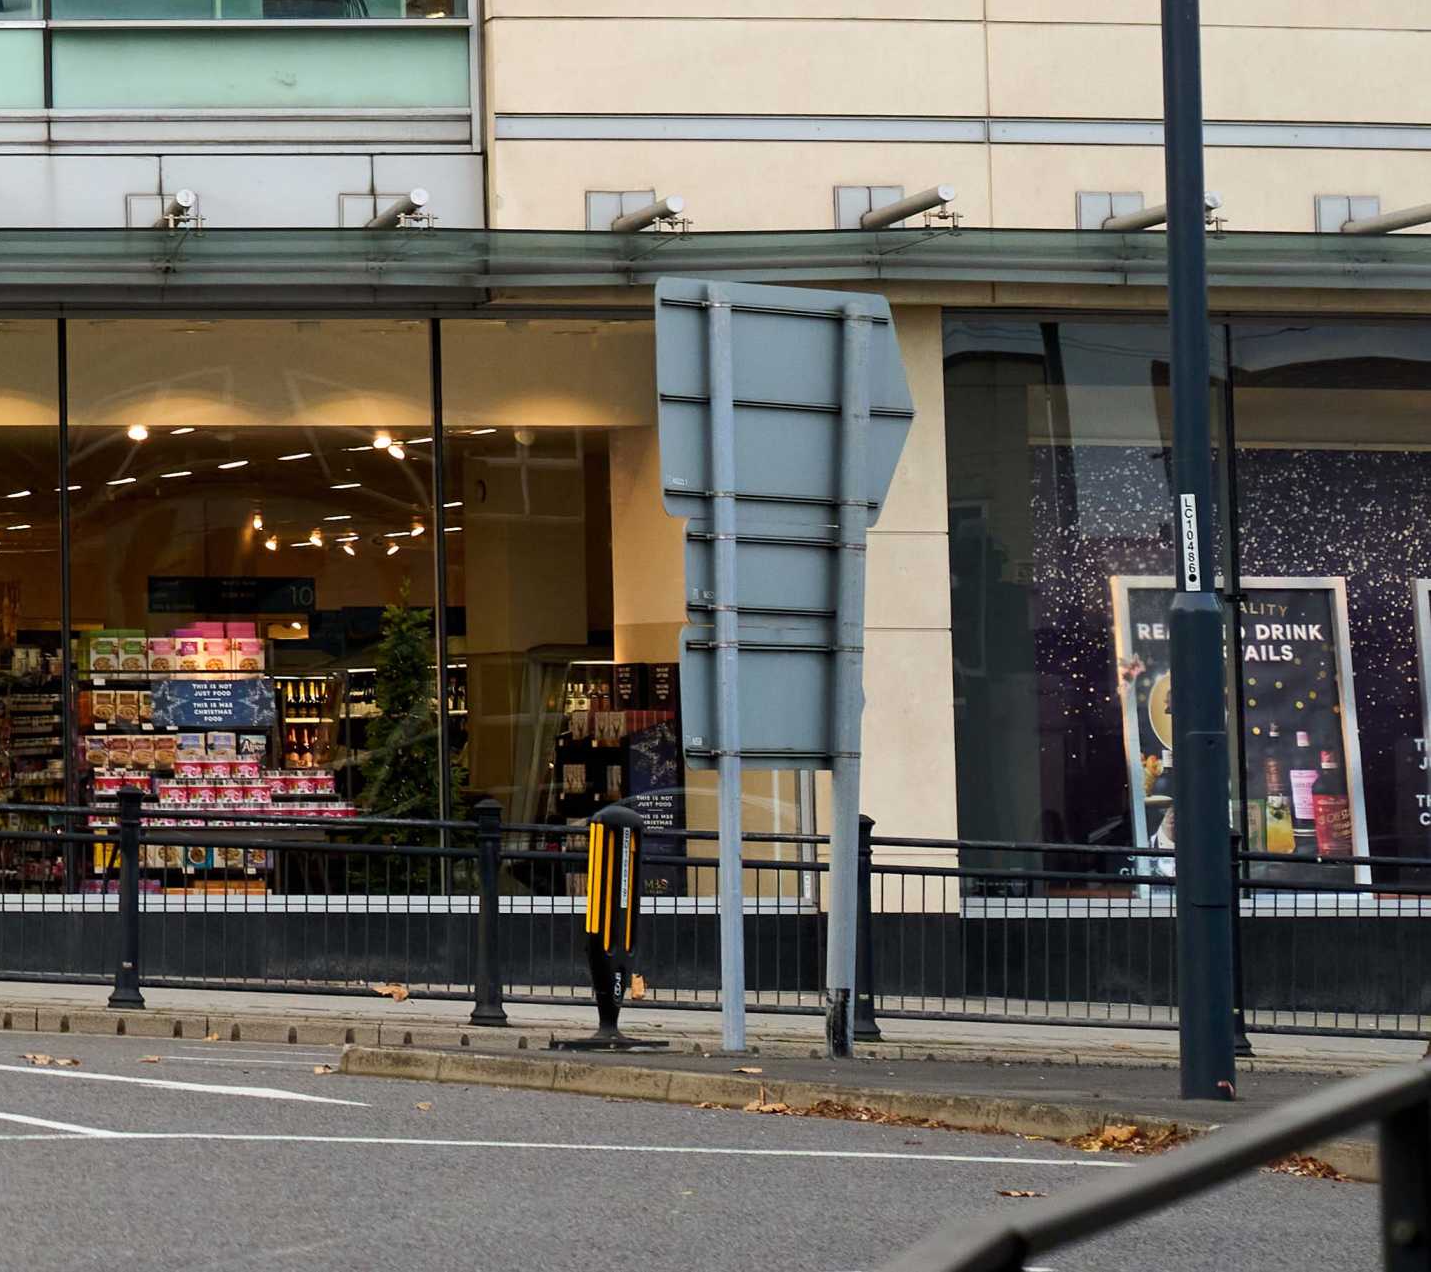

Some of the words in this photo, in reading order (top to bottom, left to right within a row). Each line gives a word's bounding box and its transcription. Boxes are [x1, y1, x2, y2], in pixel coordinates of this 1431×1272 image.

[1184, 497, 1197, 573] LC10486
[290, 586, 314, 607] 10
[1239, 602, 1288, 617] ALITY
[1256, 624, 1324, 641] DRINK
